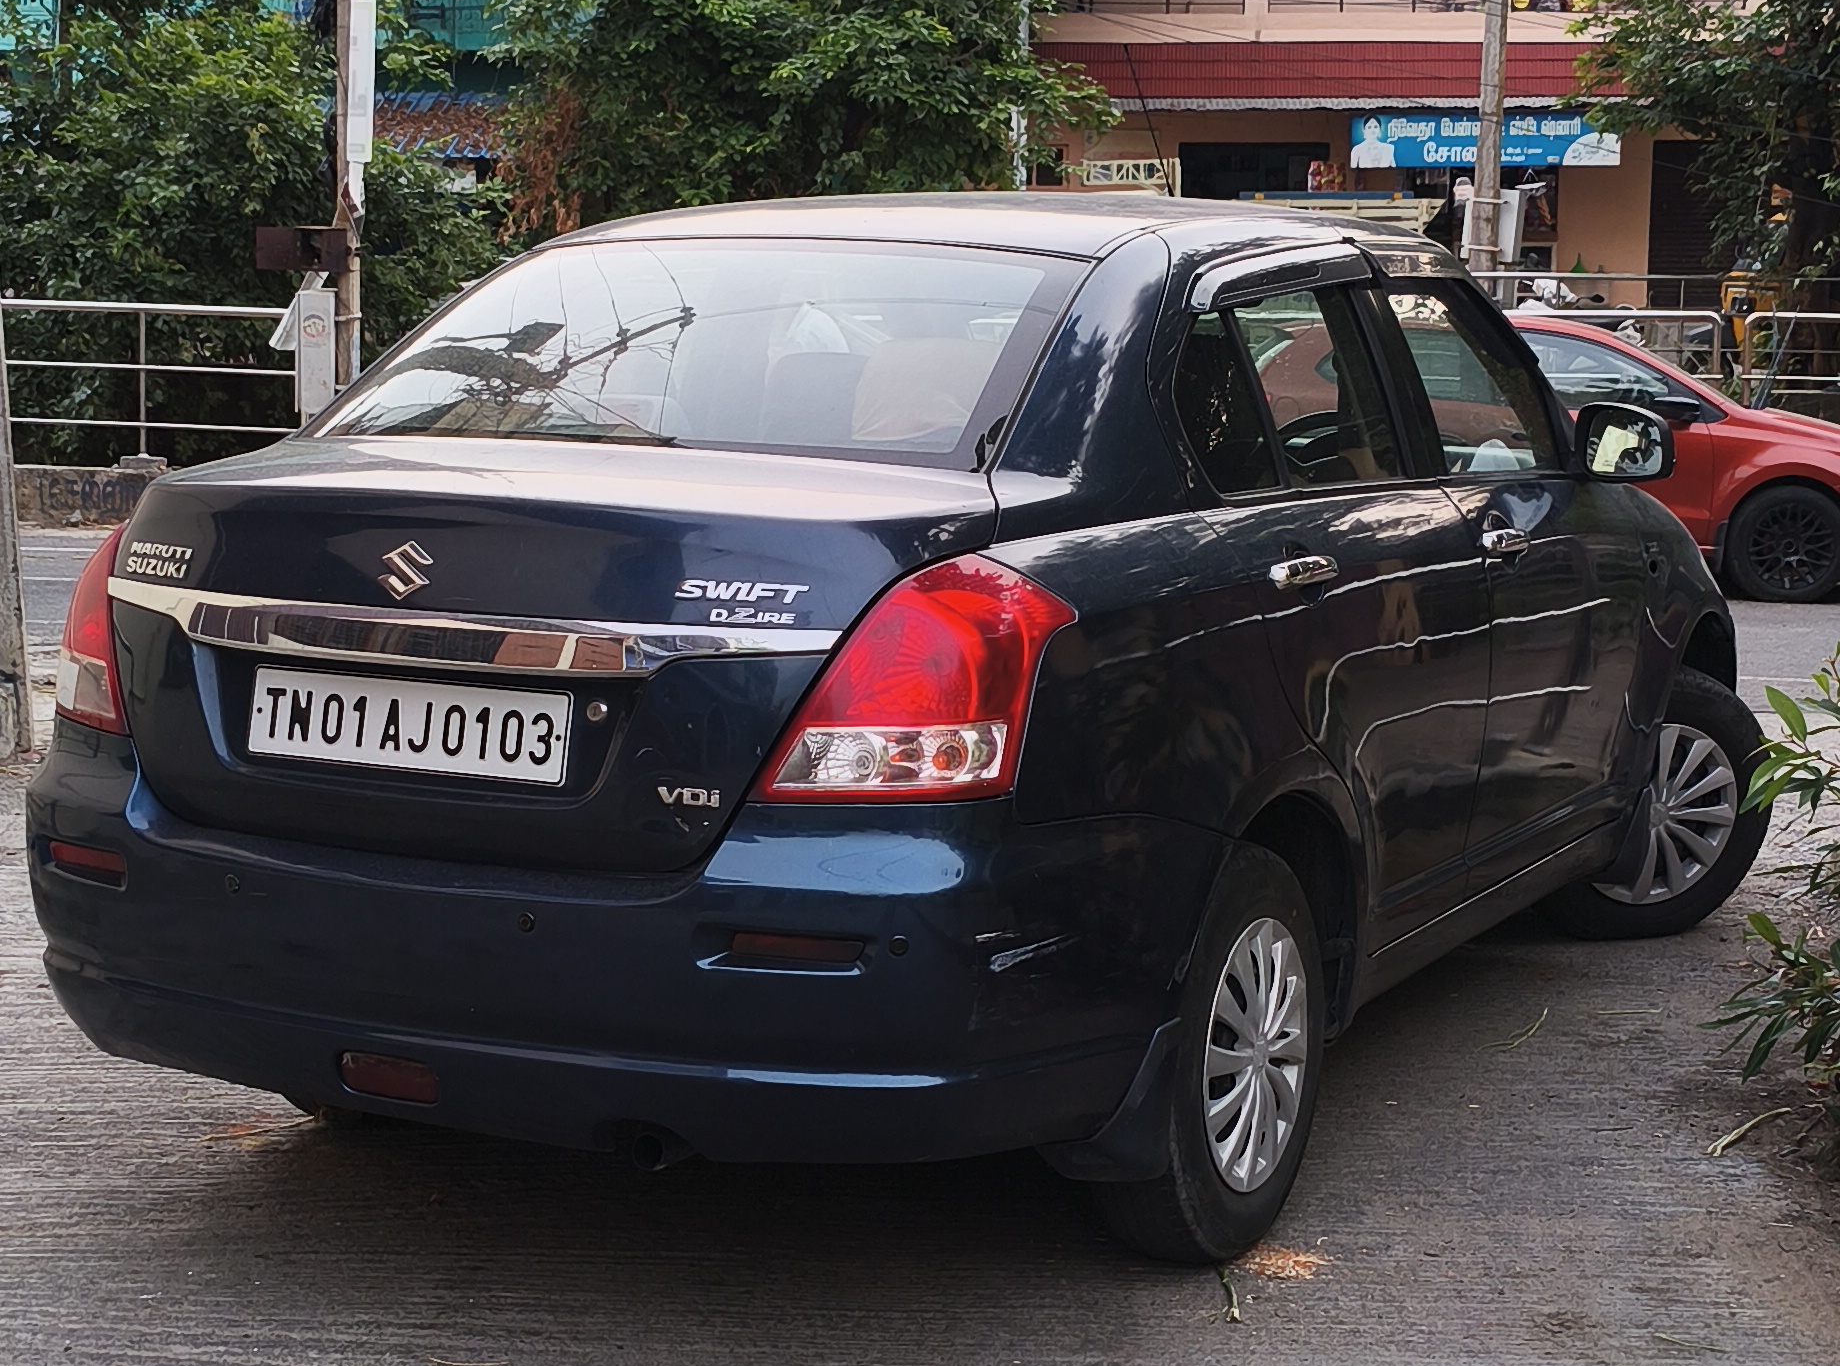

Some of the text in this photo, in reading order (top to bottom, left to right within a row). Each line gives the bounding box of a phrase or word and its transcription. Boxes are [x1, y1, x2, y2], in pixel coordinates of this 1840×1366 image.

[130, 541, 193, 560] MARUTI
[126, 556, 188, 579] SUZUKI
[674, 579, 810, 604] SWIFT
[265, 686, 554, 766] TN01AJ0103
[657, 786, 721, 808] VDi
